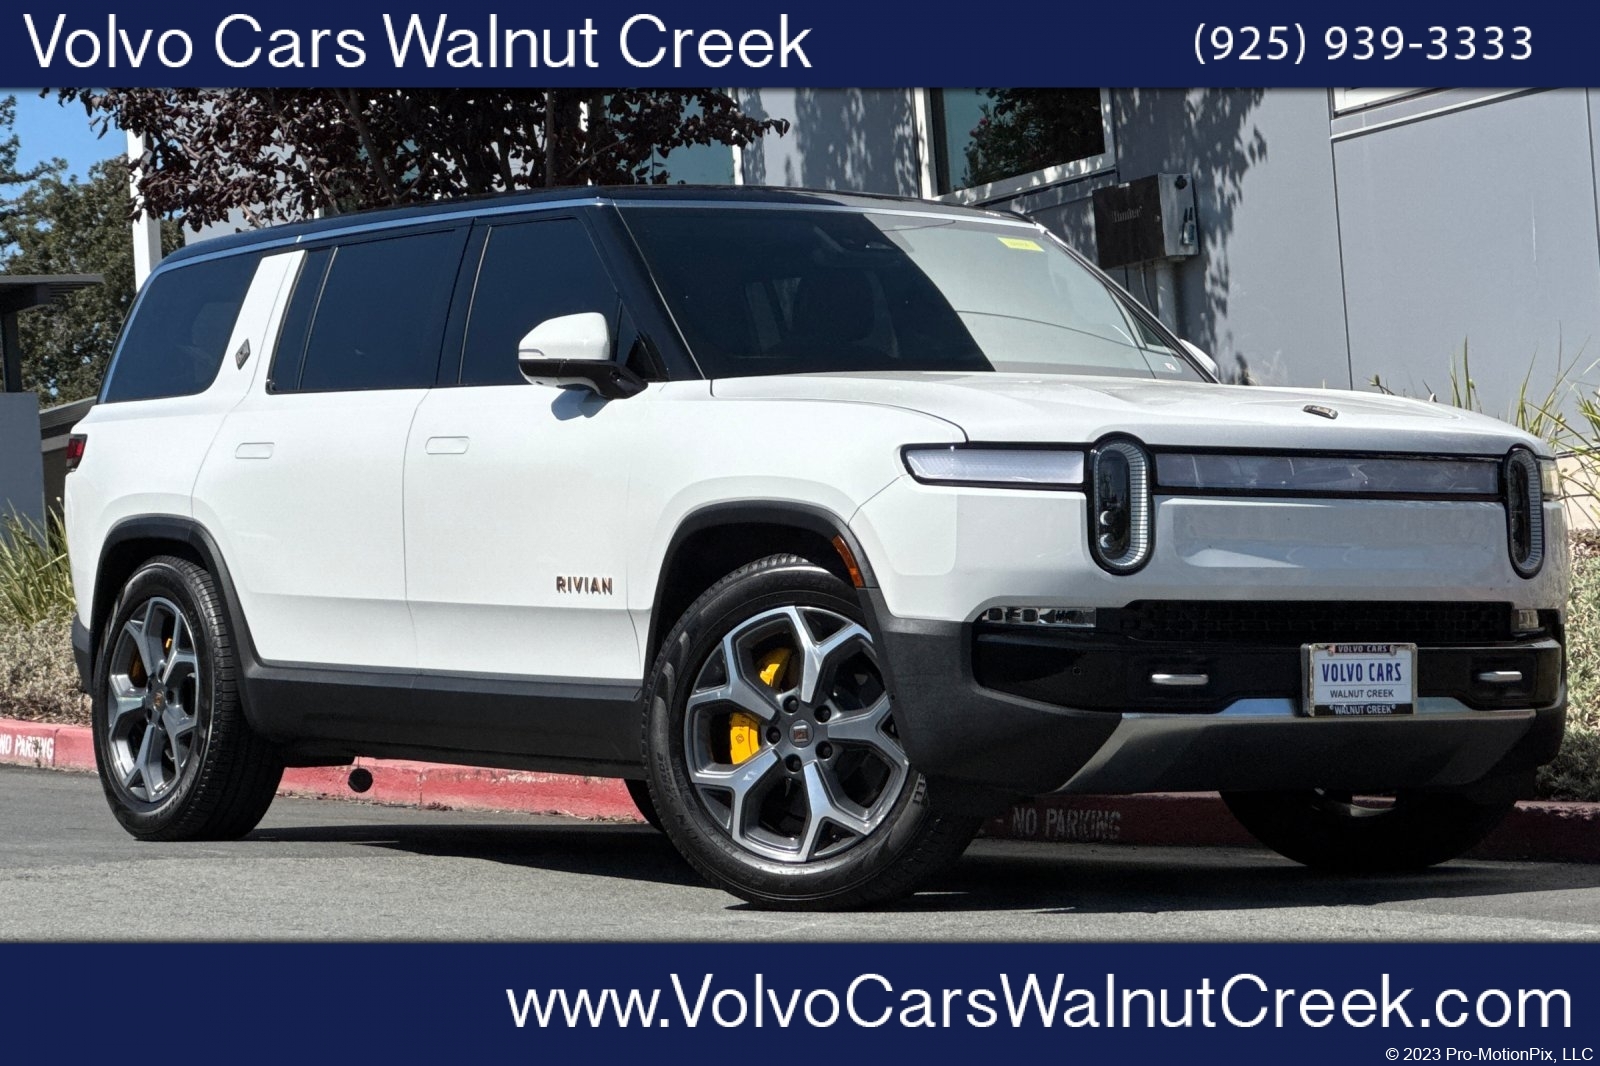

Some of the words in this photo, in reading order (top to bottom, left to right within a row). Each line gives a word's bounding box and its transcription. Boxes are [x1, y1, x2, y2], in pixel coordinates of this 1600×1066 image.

[556, 576, 613, 595] RIVIAN
[1338, 645, 1363, 653] VOLVO
[1322, 663, 1363, 682] VOLVO
[1369, 663, 1402, 681] CARS
[1330, 689, 1364, 698] WALNUT
[1366, 689, 1394, 698] CREEK
[1335, 704, 1364, 715] WALNUT
[1366, 704, 1391, 714] CREEK
[0, 733, 12, 755] NO
[1012, 807, 1037, 836] NO
[1045, 808, 1121, 839] PARKING
